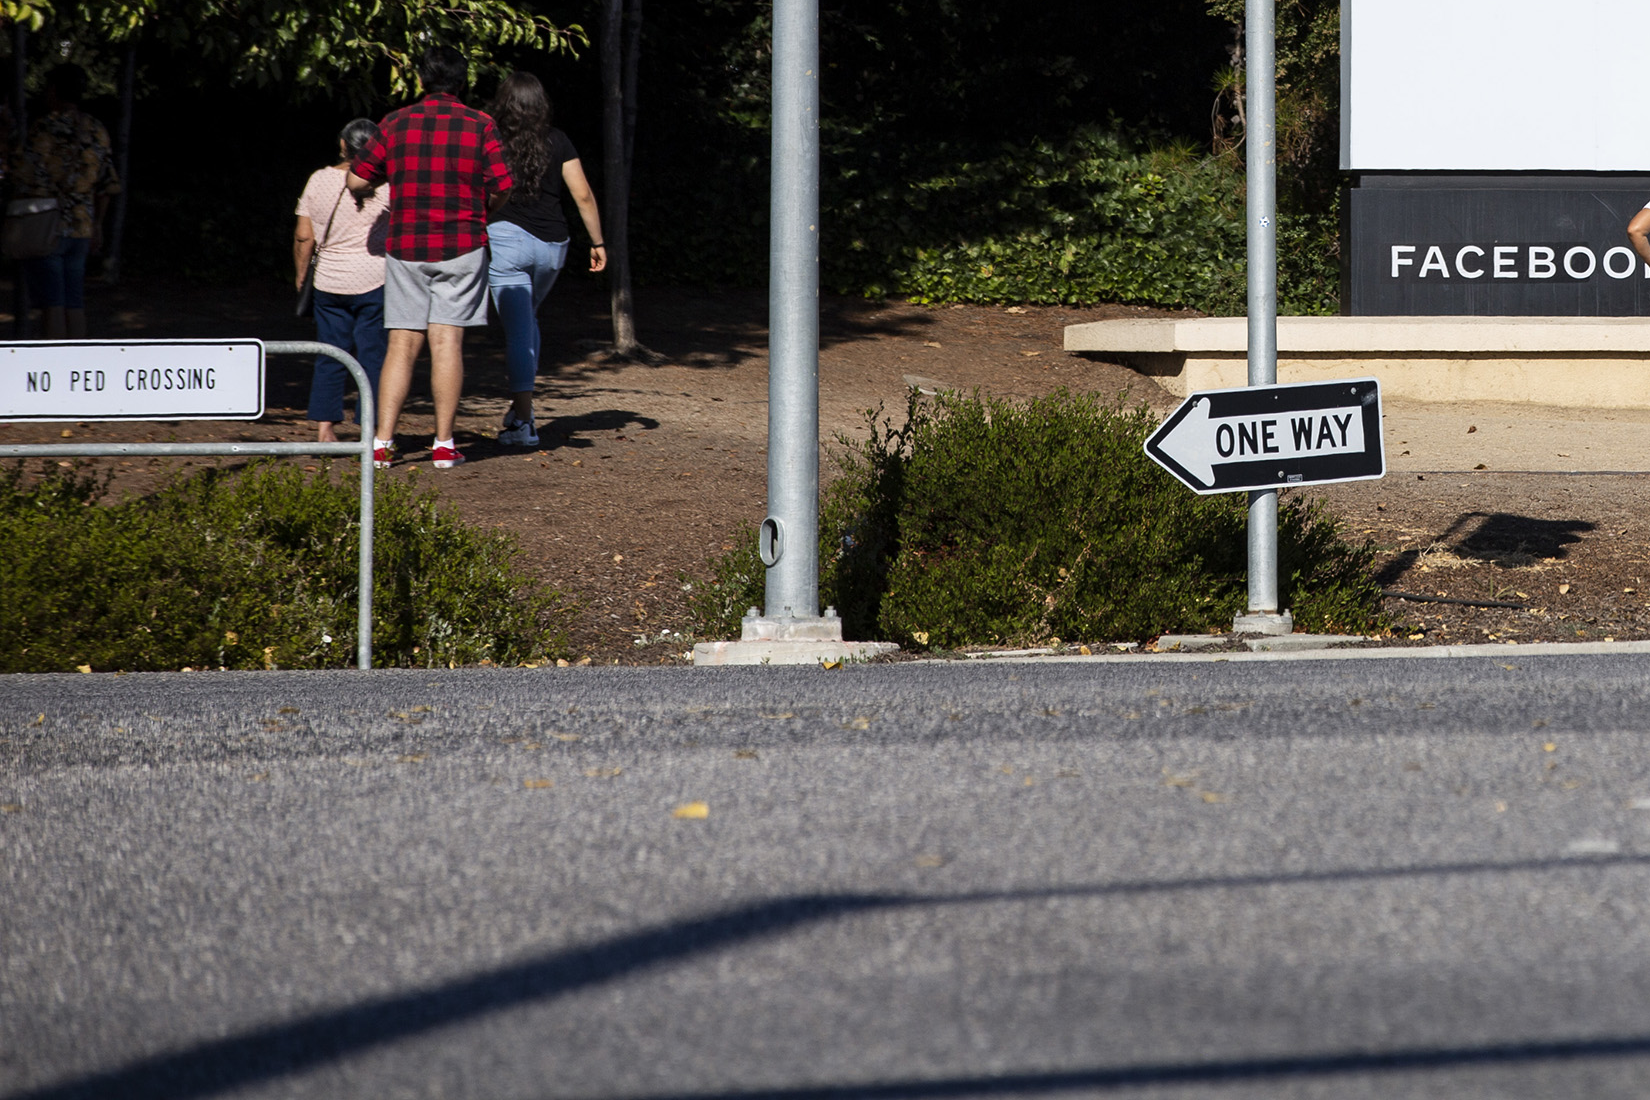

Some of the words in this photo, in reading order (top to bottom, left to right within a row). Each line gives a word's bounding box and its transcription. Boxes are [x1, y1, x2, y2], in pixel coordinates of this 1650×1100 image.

[26, 370, 51, 393] NO
[70, 369, 106, 392] PED
[125, 367, 216, 391] CROSSING
[1215, 419, 1280, 458] ONE
[1290, 413, 1353, 451] WAY
